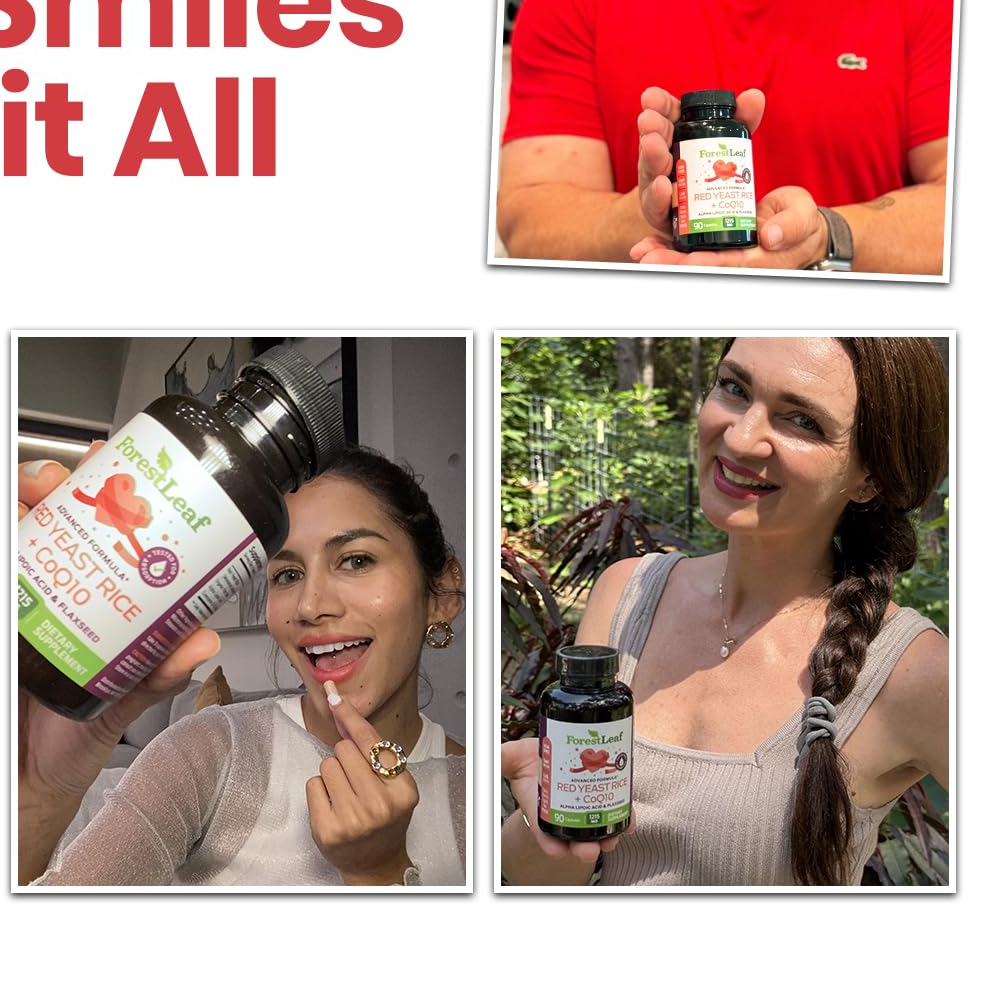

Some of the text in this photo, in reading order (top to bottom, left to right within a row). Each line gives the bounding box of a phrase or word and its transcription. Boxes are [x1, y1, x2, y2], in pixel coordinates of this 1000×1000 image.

[699, 149, 746, 158] ForestLeaf
[694, 193, 711, 201] RED
[713, 192, 740, 200] YEAST
[719, 201, 744, 209] CoQ10
[115, 435, 212, 533] ForestLeaf
[57, 504, 88, 540] ADVANCED
[29, 538, 92, 607] + CoQ10
[48, 521, 104, 580] YEAST
[96, 577, 143, 623] RICE
[18, 585, 33, 608] 215
[32, 575, 53, 596] ACID
[50, 595, 58, 603] &
[57, 602, 101, 644] FLAXSEED
[40, 619, 81, 654] DIETARY
[32, 629, 88, 676] SUPPLEMENT
[566, 731, 624, 745] ForestLeaf
[557, 782, 576, 792] RED
[578, 782, 610, 793] YEAST
[584, 792, 614, 804] CoQ10
[554, 813, 565, 823] 90
